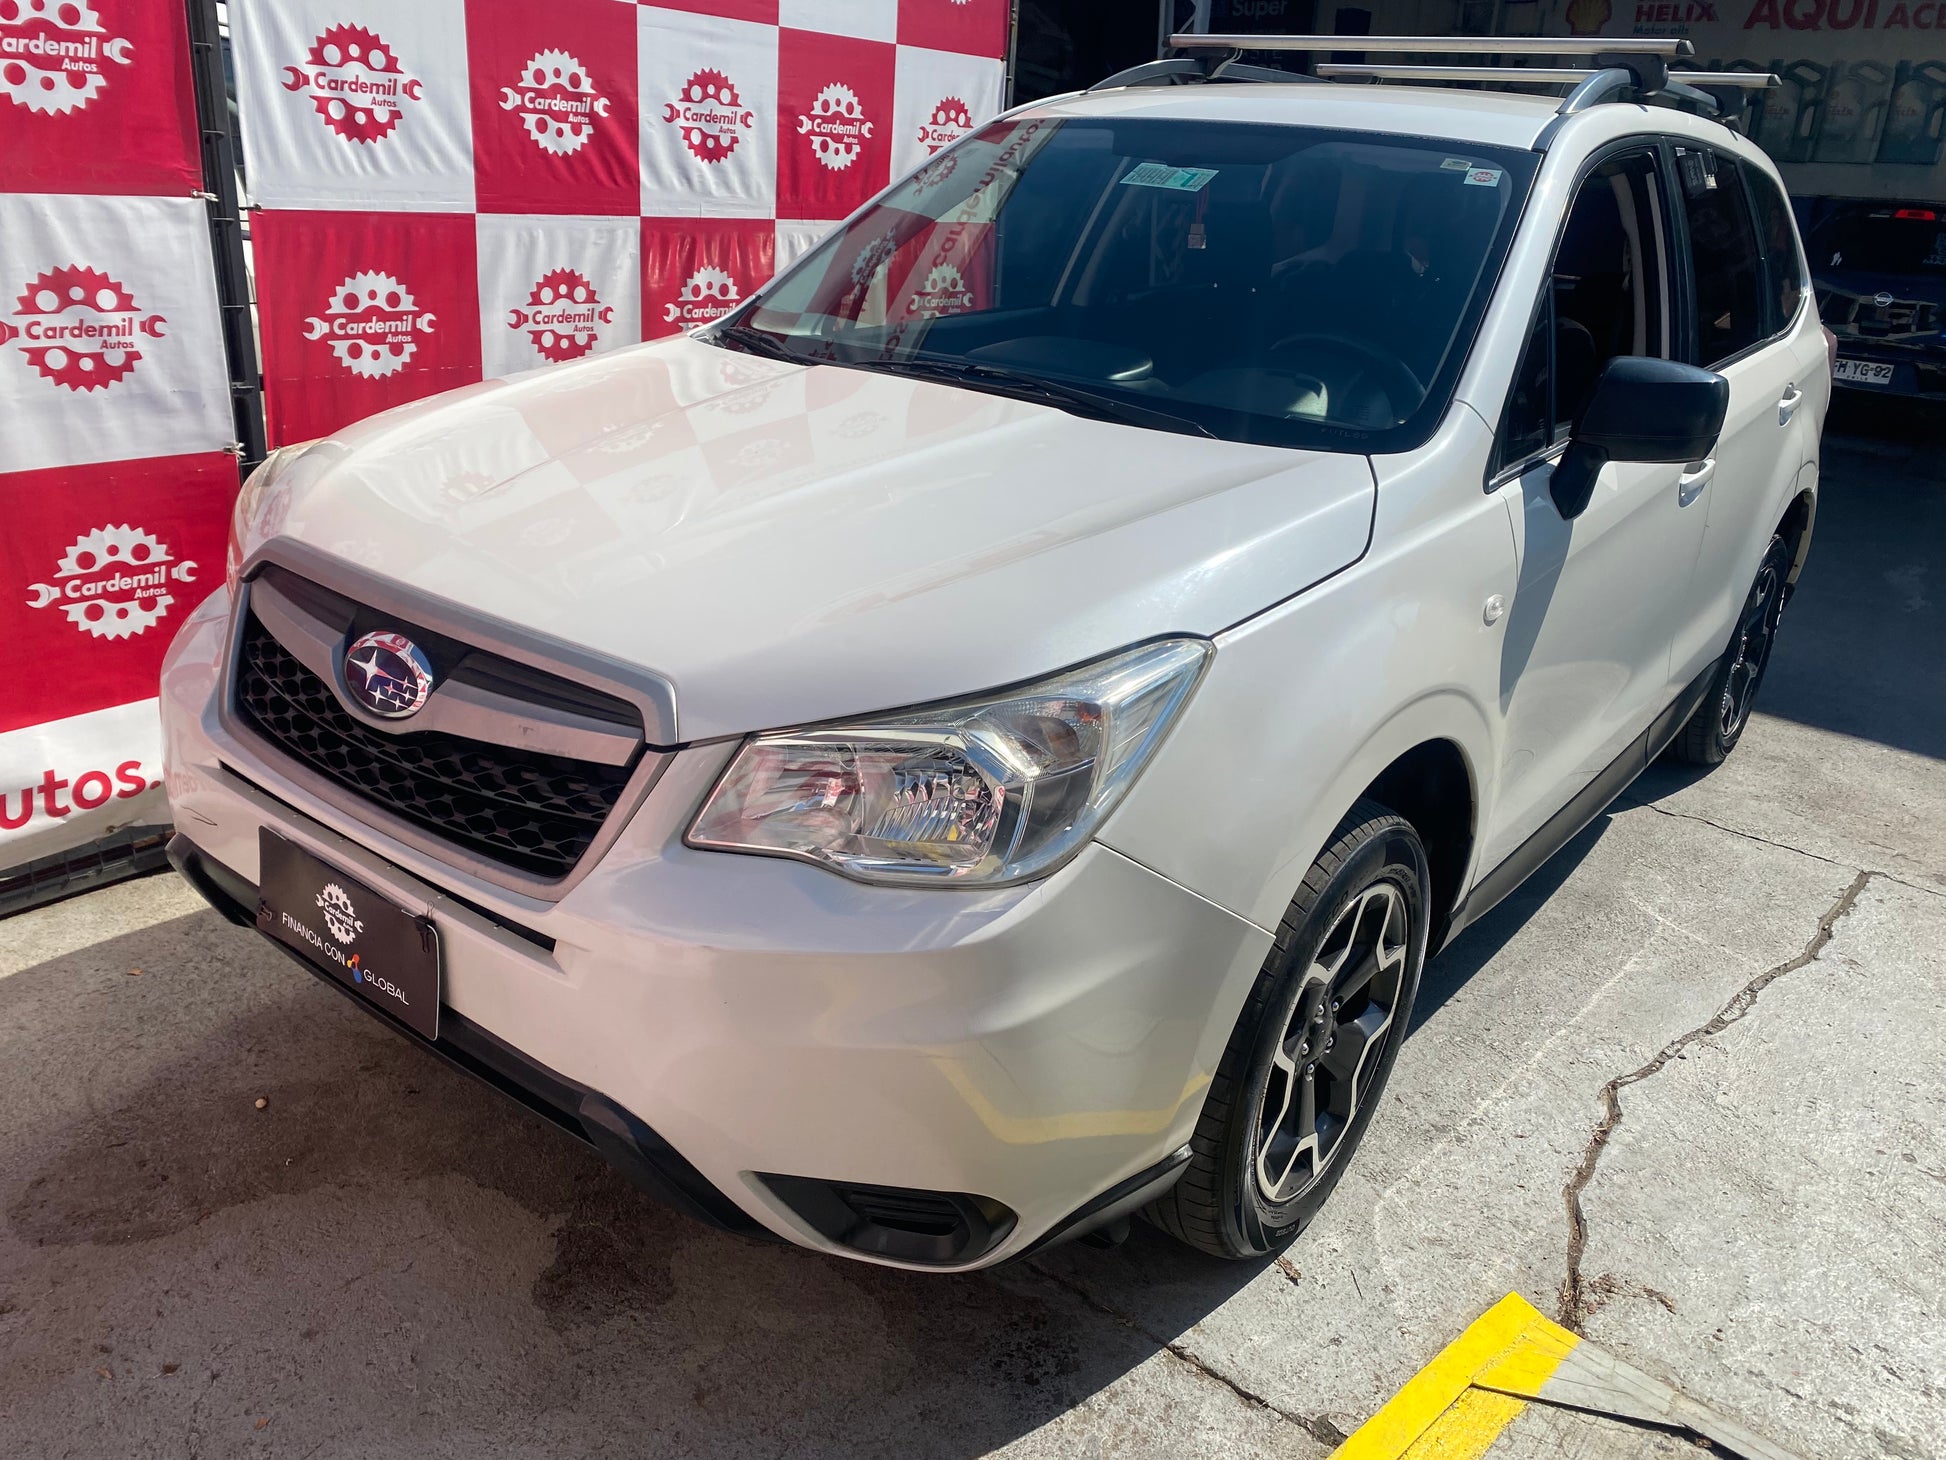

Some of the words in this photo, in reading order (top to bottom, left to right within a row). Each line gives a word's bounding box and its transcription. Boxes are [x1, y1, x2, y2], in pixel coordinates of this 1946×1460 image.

[1232, 0, 1289, 20] Super
[1635, 1, 1718, 22] HELIX
[1633, 24, 1666, 35] Motor
[0, 31, 97, 58] ardemil
[62, 58, 97, 72] Autos
[314, 71, 397, 96] Cardemil
[370, 96, 397, 108] Autos
[524, 91, 591, 113] Cardemil
[568, 113, 589, 123] Autos
[683, 107, 737, 126] Cardemil
[718, 126, 736, 135] Autos
[813, 118, 859, 135] Cardemil
[333, 314, 413, 335] Cardemil
[532, 307, 595, 325] Cardemil
[25, 317, 133, 340] Cardemil
[573, 324, 594, 332] Autos
[100, 339, 134, 350] Autos
[385, 333, 412, 343] Autos
[65, 565, 166, 598] Cardemil
[134, 586, 167, 599] Autos
[324, 901, 354, 926] Cardemil
[282, 912, 323, 951] FINANCIA
[324, 942, 346, 966] CON
[363, 969, 410, 1006] GLOBAL
